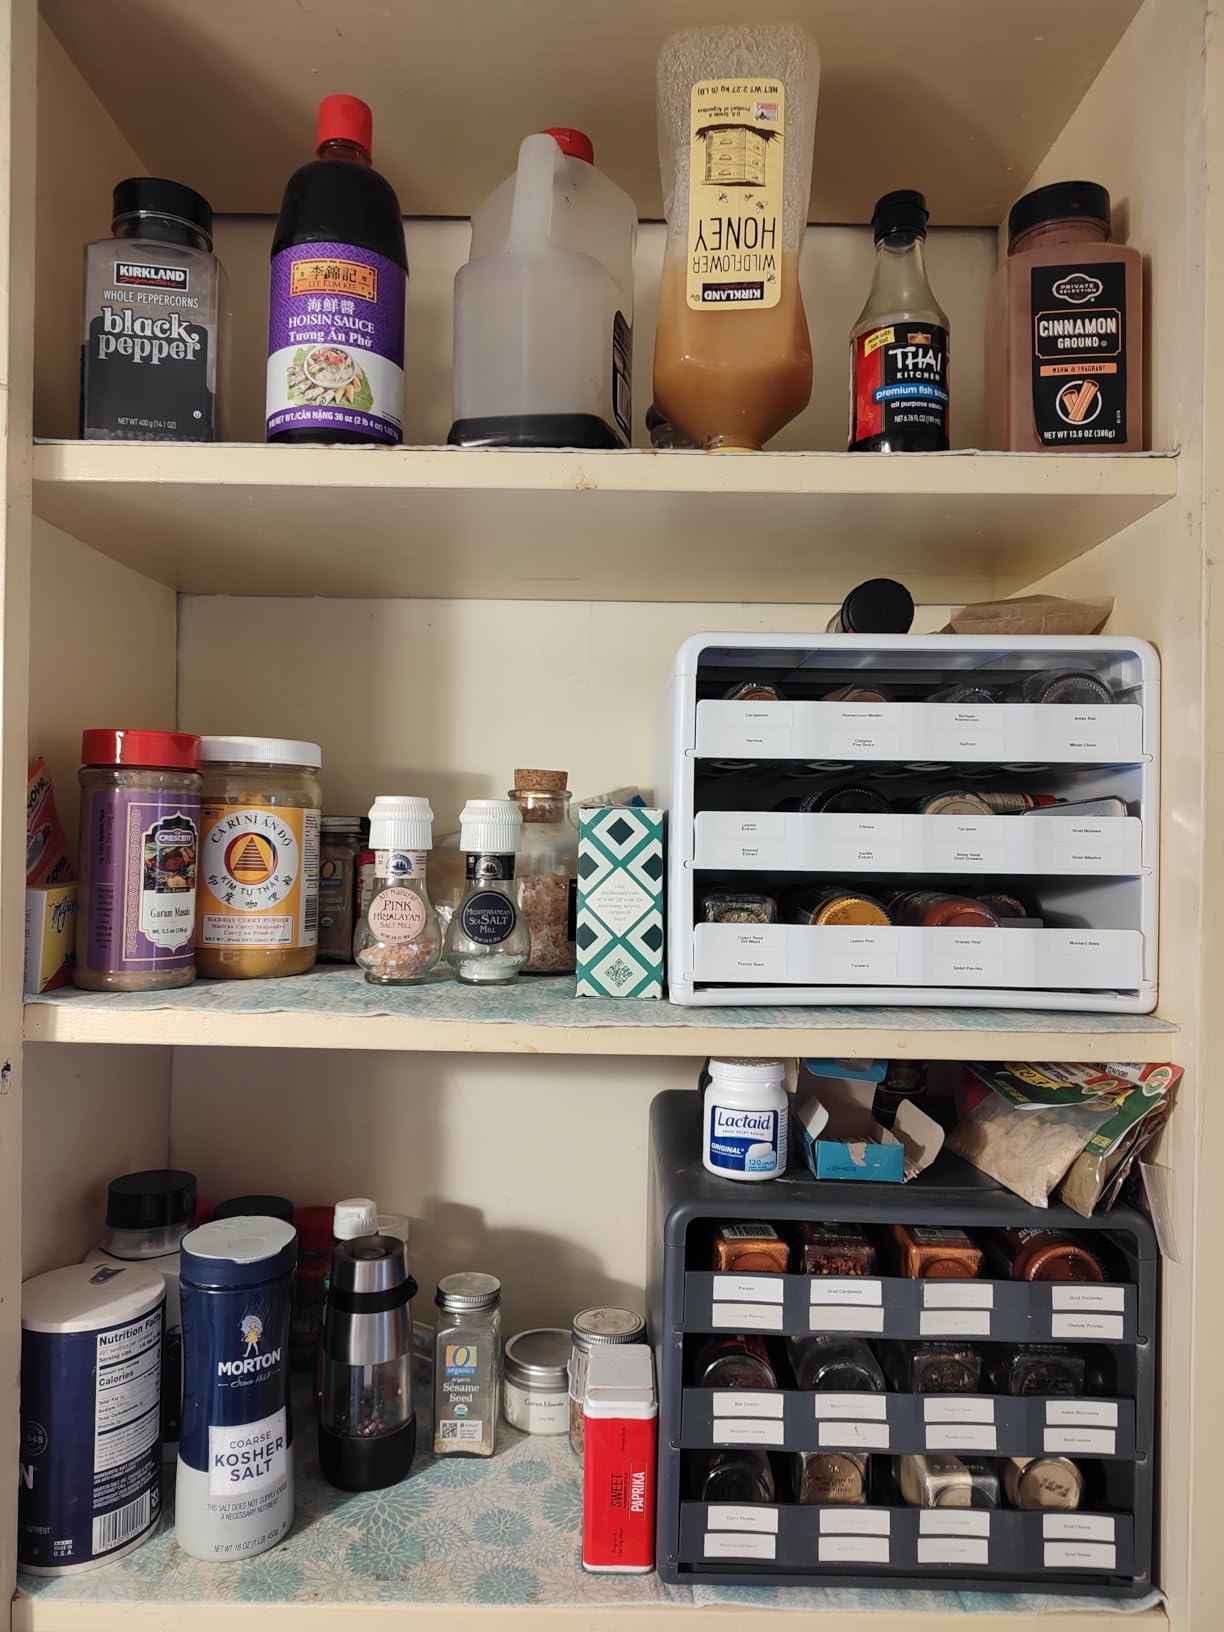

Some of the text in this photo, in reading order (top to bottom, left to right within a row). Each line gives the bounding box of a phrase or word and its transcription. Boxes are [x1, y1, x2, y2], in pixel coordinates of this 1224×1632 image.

[732, 86, 748, 94] 2.27
[750, 85, 762, 93] WT
[764, 85, 778, 93] NET
[695, 216, 776, 252] HONEY
[692, 254, 776, 274] WILDFLOWER
[119, 265, 185, 282] KIRKLAND
[310, 265, 357, 283] 李錦記
[309, 280, 321, 288] LEE
[103, 289, 199, 309] WHOLE PEPPERCORNS
[704, 288, 761, 300] KIRKLAND
[101, 307, 199, 343] black
[288, 314, 375, 334] HOISIN SAUCE
[1039, 317, 1116, 338] CINNAMON
[97, 333, 201, 364] pepper
[1057, 336, 1099, 349] GROUND
[888, 346, 942, 372] THAI
[896, 371, 940, 381] KITCHEN
[1077, 365, 1106, 373] FRAGRANT
[876, 386, 918, 400] premium
[918, 385, 933, 396] fish
[890, 401, 900, 409] all
[900, 401, 928, 409] purpose
[117, 417, 128, 426] NET
[128, 418, 138, 426] WT
[312, 409, 333, 422] NẶNG
[335, 412, 344, 421] 36
[344, 415, 353, 423] oz
[1044, 431, 1057, 439] NET
[1057, 430, 1068, 439] WT
[1069, 430, 1083, 439] 13.6
[1084, 429, 1093, 438] OZ
[220, 876, 237, 891] KIM
[379, 889, 418, 902] All Natural
[150, 907, 173, 918] Garam
[383, 899, 412, 912] PINK
[466, 908, 510, 916] MEDITERRANEAN
[373, 913, 421, 921] HIMALAYAN
[480, 914, 508, 925] SALT
[480, 925, 496, 934] MILL
[717, 1111, 771, 1130] Lactaid
[711, 1142, 741, 1154] ORIGINAL
[99, 1325, 143, 1346] Nutrition
[99, 1354, 120, 1363] Serving
[217, 1347, 281, 1376] MORTON
[99, 1371, 134, 1387] Calories
[230, 1375, 255, 1388] Since
[443, 1382, 480, 1393] Sesame
[449, 1393, 473, 1403] Seed
[229, 1430, 272, 1449] COARSE
[215, 1436, 283, 1467] KOSHER
[230, 1458, 272, 1482] SALT
[609, 1472, 624, 1509] SWEET
[630, 1471, 646, 1513] PAPRIKA
[207, 1503, 218, 1512] THIS
[218, 1503, 231, 1512] SALT
[232, 1501, 247, 1512] DOES
[247, 1498, 258, 1508] NOT
[259, 1491, 276, 1505] SUPPLY
[226, 1508, 257, 1520] NECESSARY
[257, 1496, 279, 1513] NUTRIENT
[213, 1545, 224, 1553] NET
[224, 1544, 233, 1553] WT
[242, 1540, 251, 1550] OZ
[257, 1535, 266, 1545] LB)
